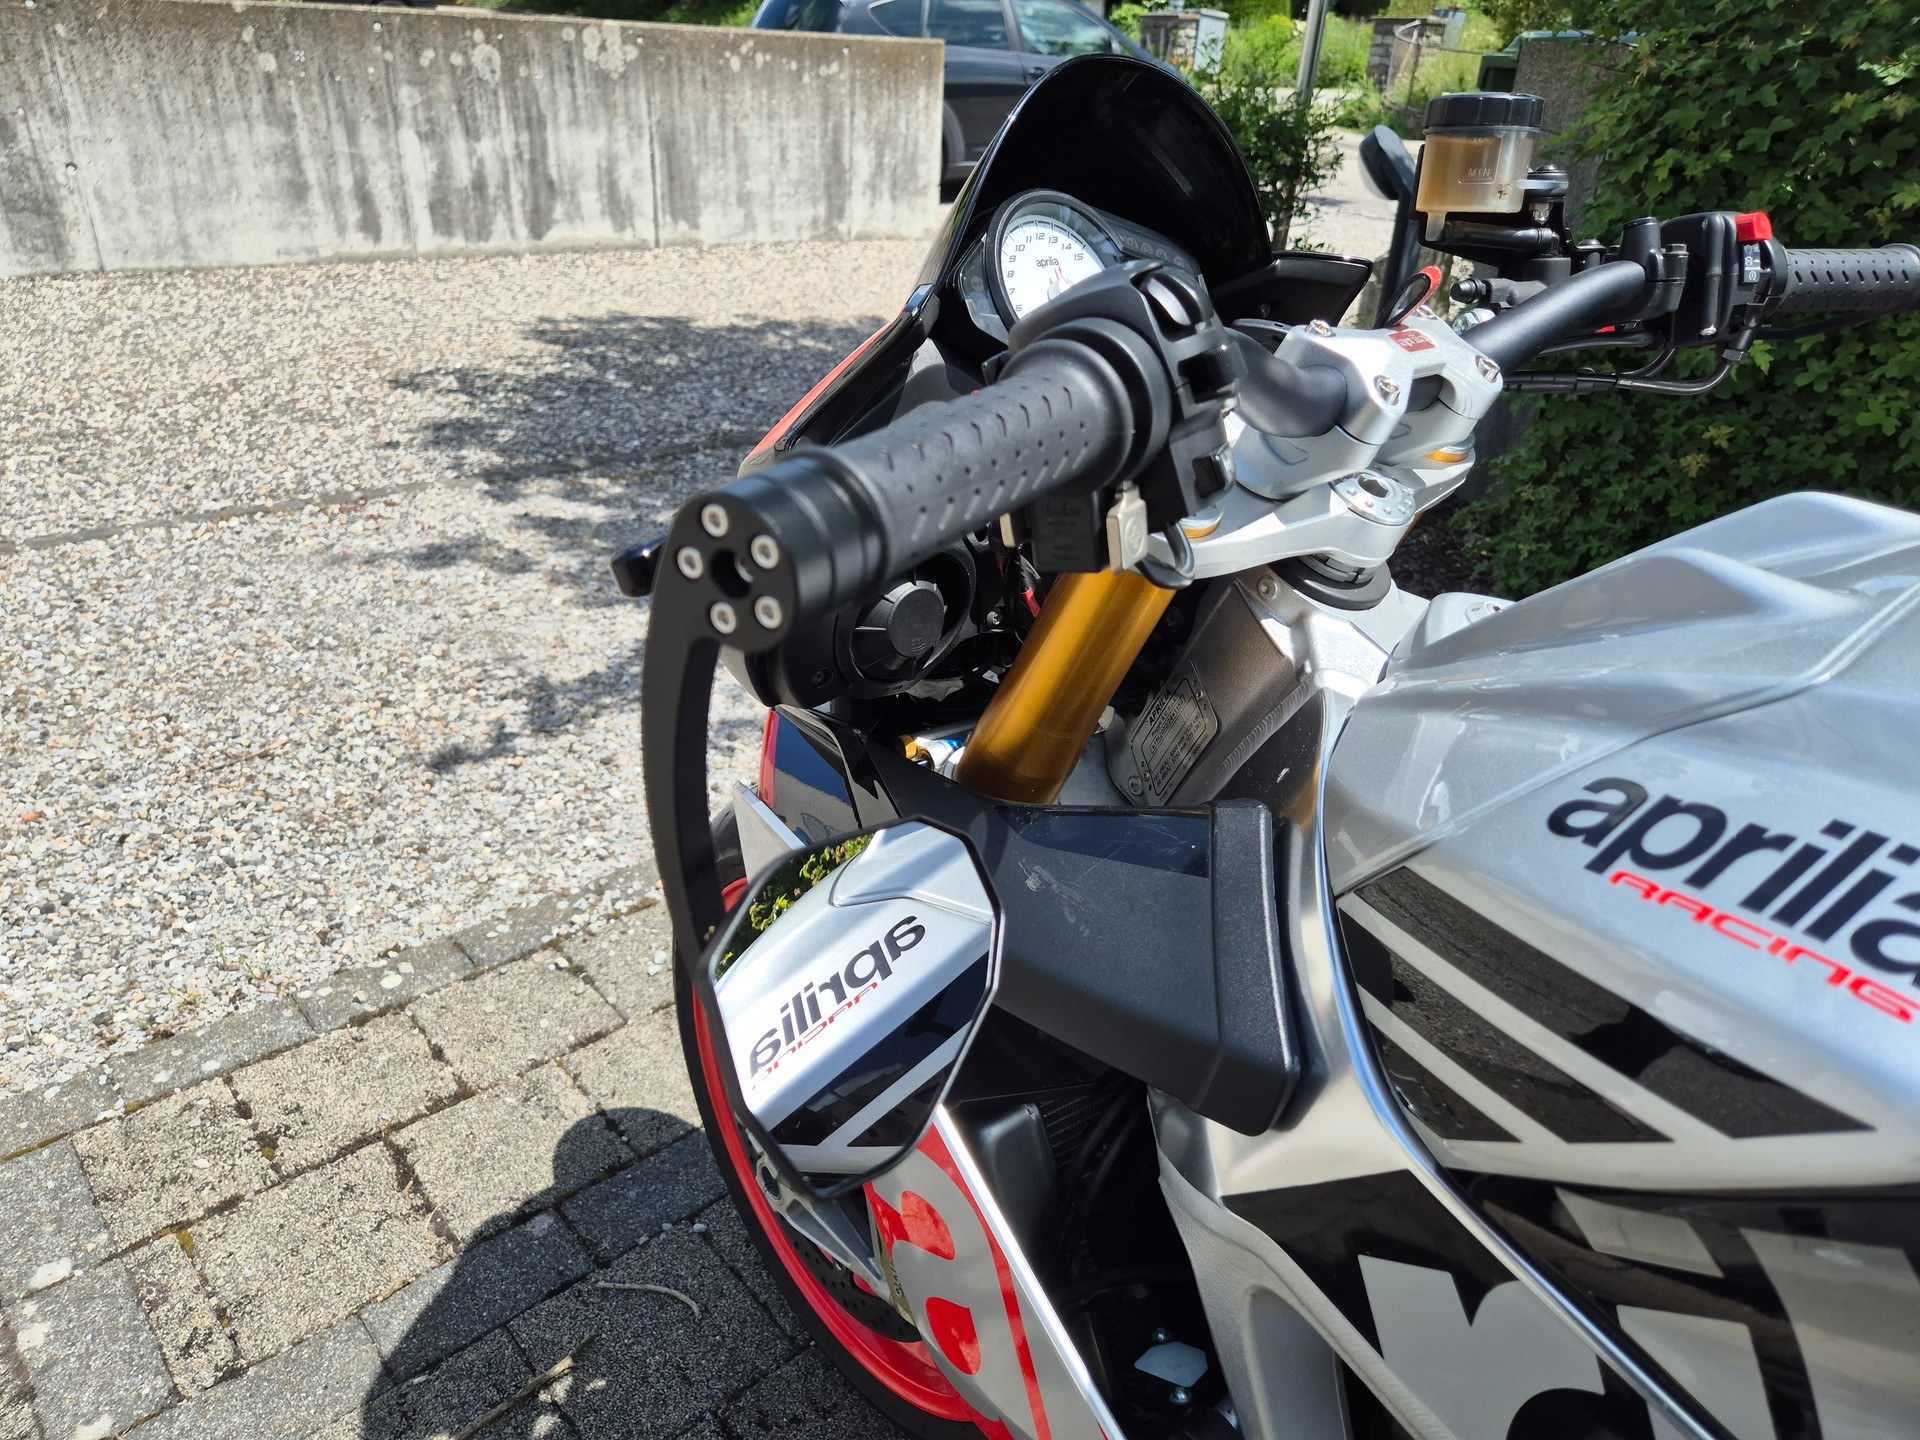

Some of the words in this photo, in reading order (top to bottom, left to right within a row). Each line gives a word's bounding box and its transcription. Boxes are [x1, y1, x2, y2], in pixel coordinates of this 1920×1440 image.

[1467, 168, 1491, 178] MIN
[1048, 236, 1058, 244] 13
[1015, 244, 1026, 252] 10
[1061, 243, 1072, 251] 14
[1074, 253, 1083, 261] 15
[1036, 256, 1060, 268] aprilia
[1007, 270, 1014, 278] 8
[1148, 688, 1172, 726] APRILIA
